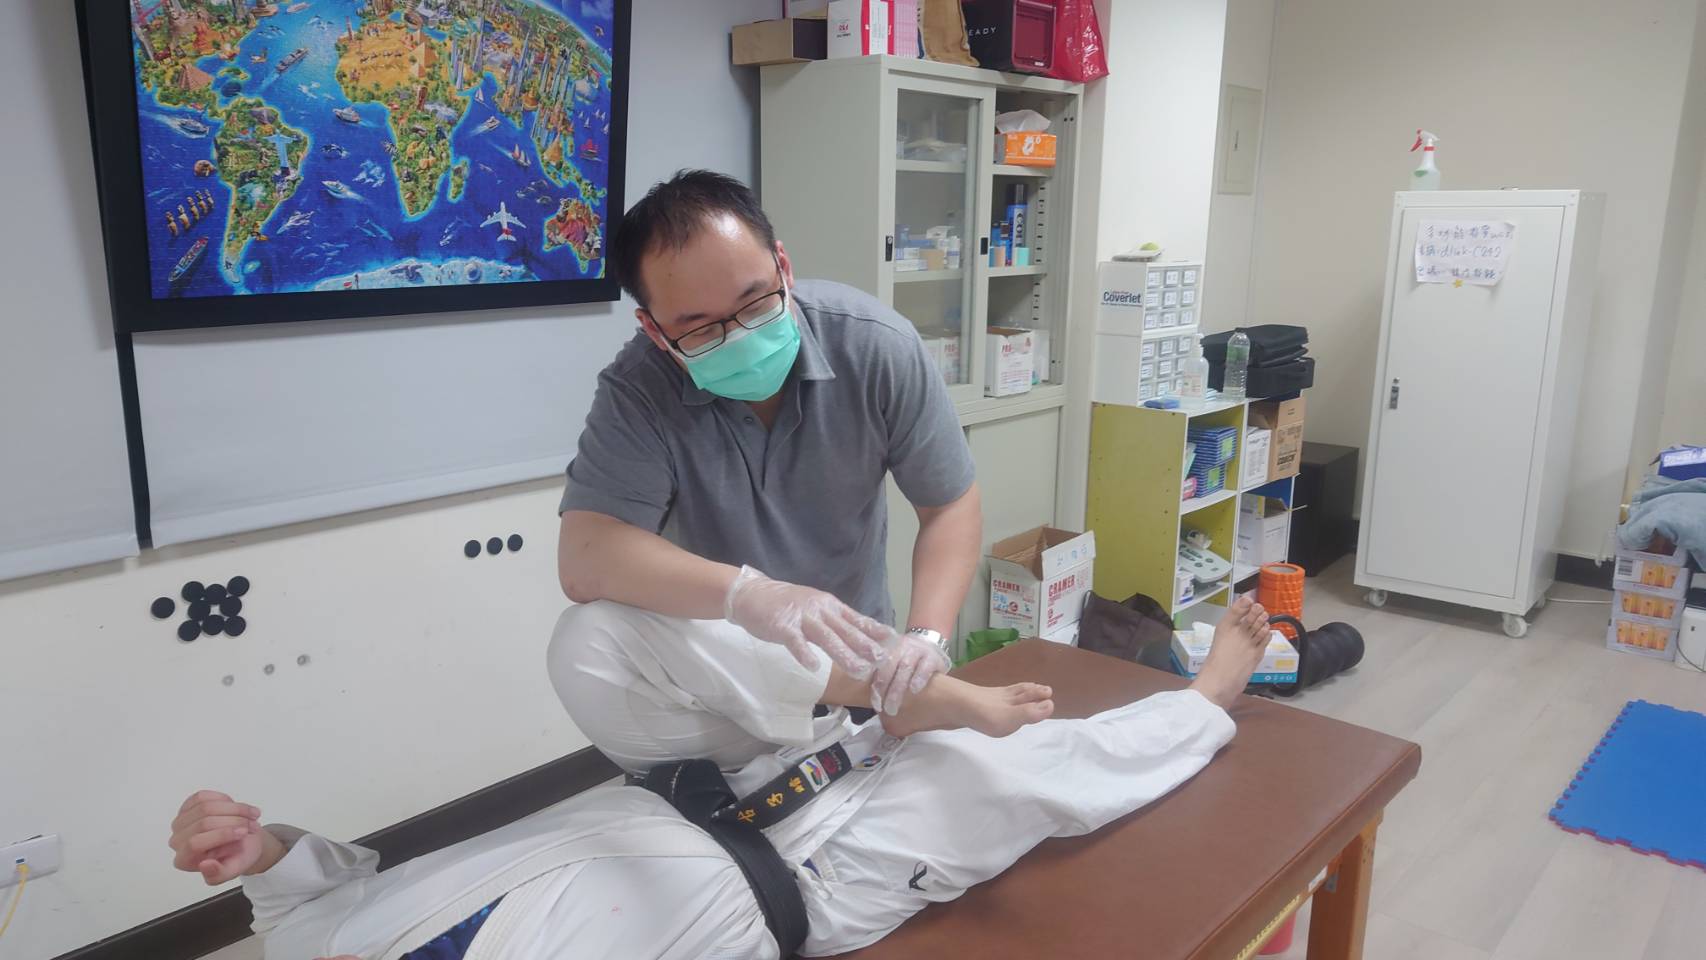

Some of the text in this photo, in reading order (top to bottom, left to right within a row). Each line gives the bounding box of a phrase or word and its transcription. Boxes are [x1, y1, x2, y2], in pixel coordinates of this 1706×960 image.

[1103, 291, 1142, 304] Coverlet
[992, 579, 1020, 593] CRAMER
[1048, 574, 1076, 598] CRAMER
